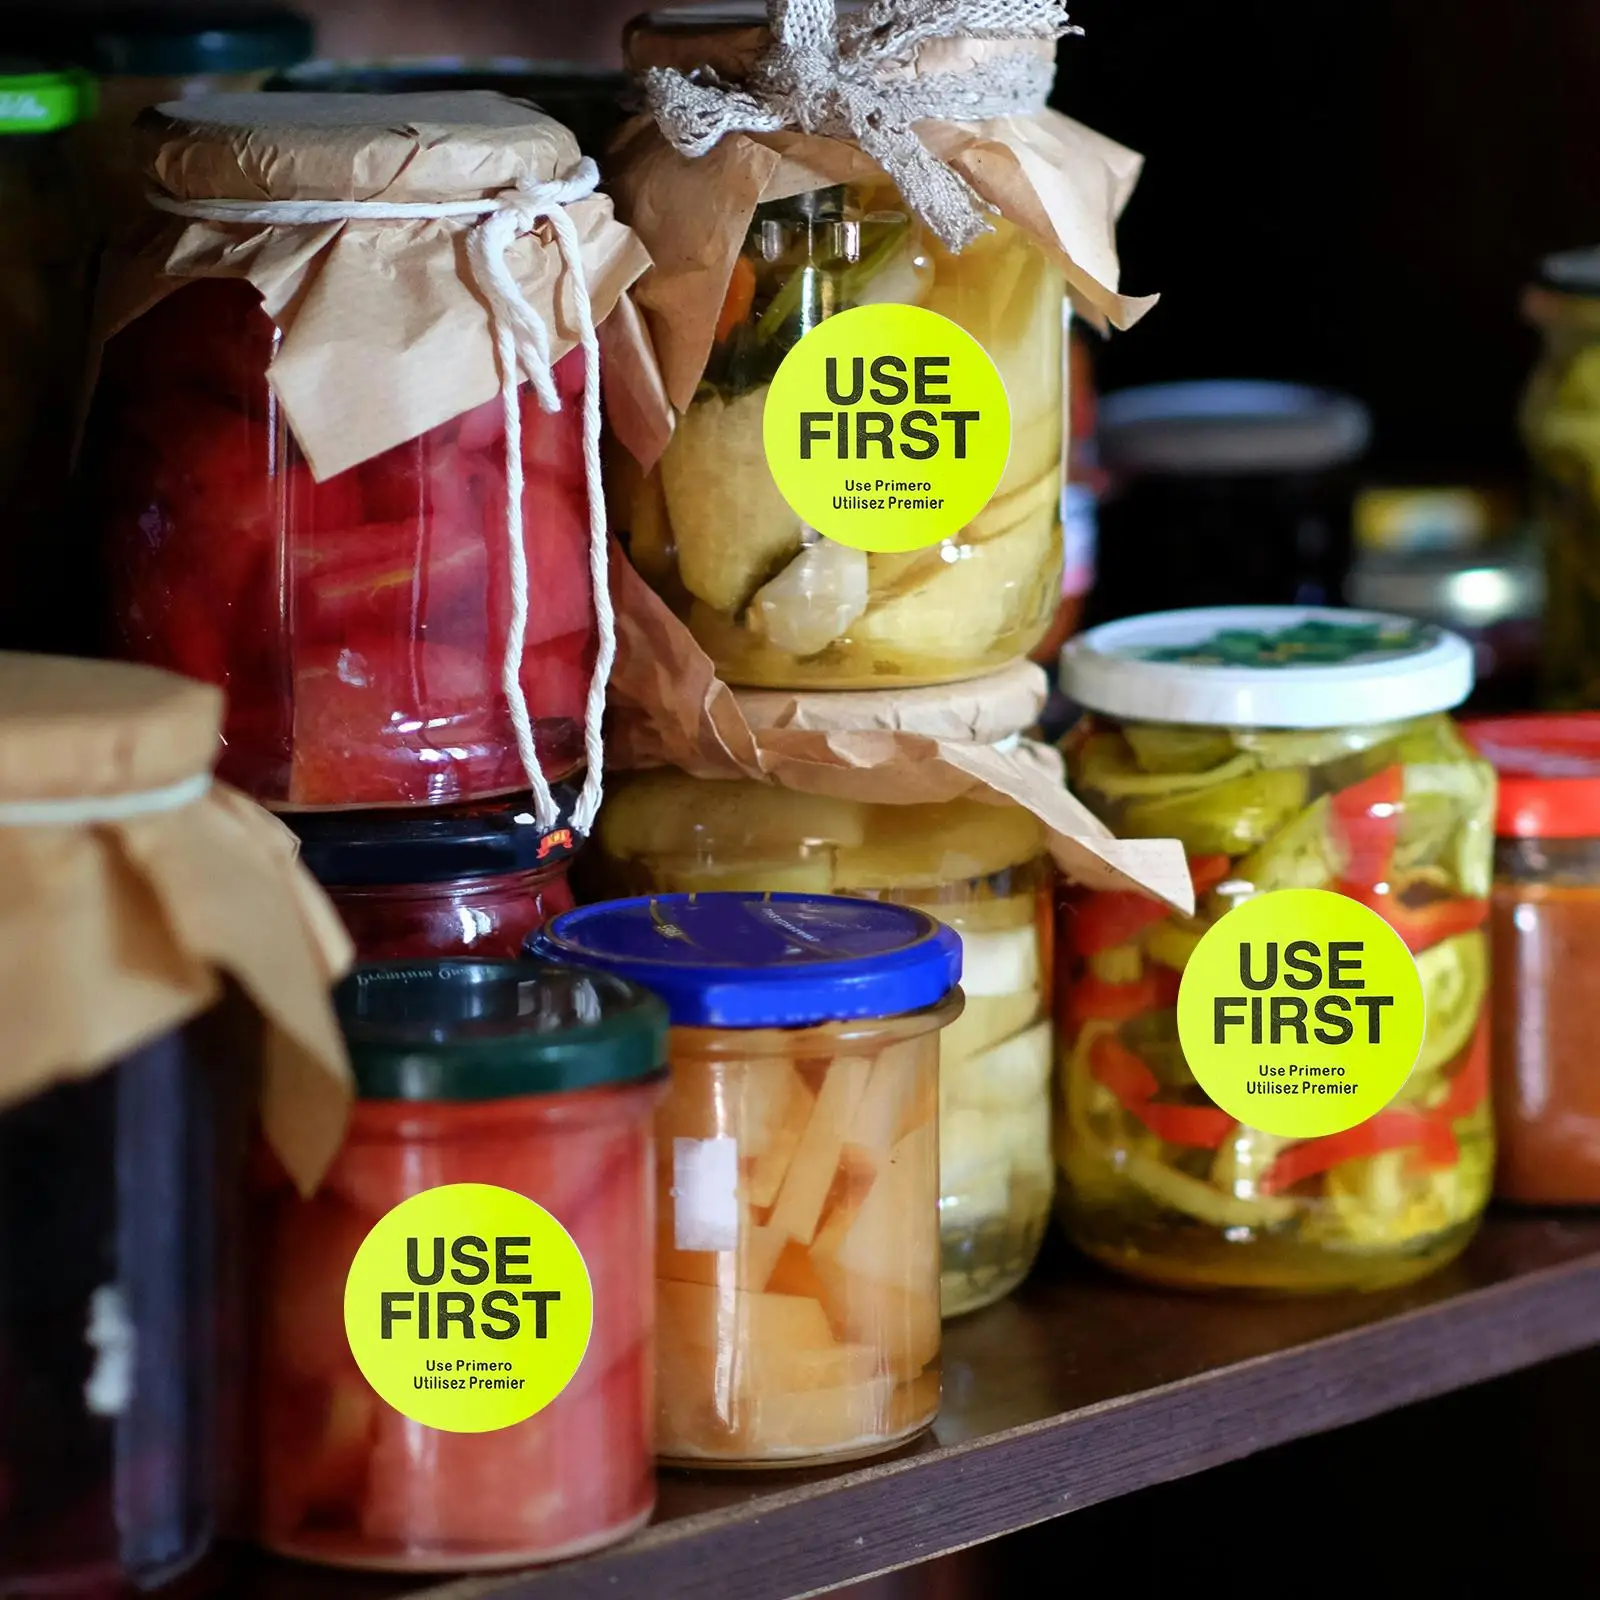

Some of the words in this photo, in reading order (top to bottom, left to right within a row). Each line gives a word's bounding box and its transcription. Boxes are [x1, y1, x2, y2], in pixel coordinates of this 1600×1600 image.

[826, 356, 951, 405] USE
[799, 410, 980, 460] FIRST
[845, 480, 872, 492] Use
[875, 479, 932, 492] Primero
[832, 495, 885, 510] Utilisez
[888, 495, 945, 510] Premier
[1240, 941, 1365, 990] USE
[1213, 995, 1394, 1045] FIRST
[1259, 1065, 1286, 1077] Use
[1289, 1064, 1346, 1077] Primero
[1246, 1080, 1299, 1095] Utilisez
[1302, 1080, 1359, 1095] Premier
[407, 1236, 532, 1285] USE
[380, 1290, 561, 1340] FIRST
[426, 1360, 453, 1372] Use
[456, 1359, 513, 1372] Primero
[413, 1375, 466, 1390] Utilisez
[469, 1375, 526, 1390] Premier
